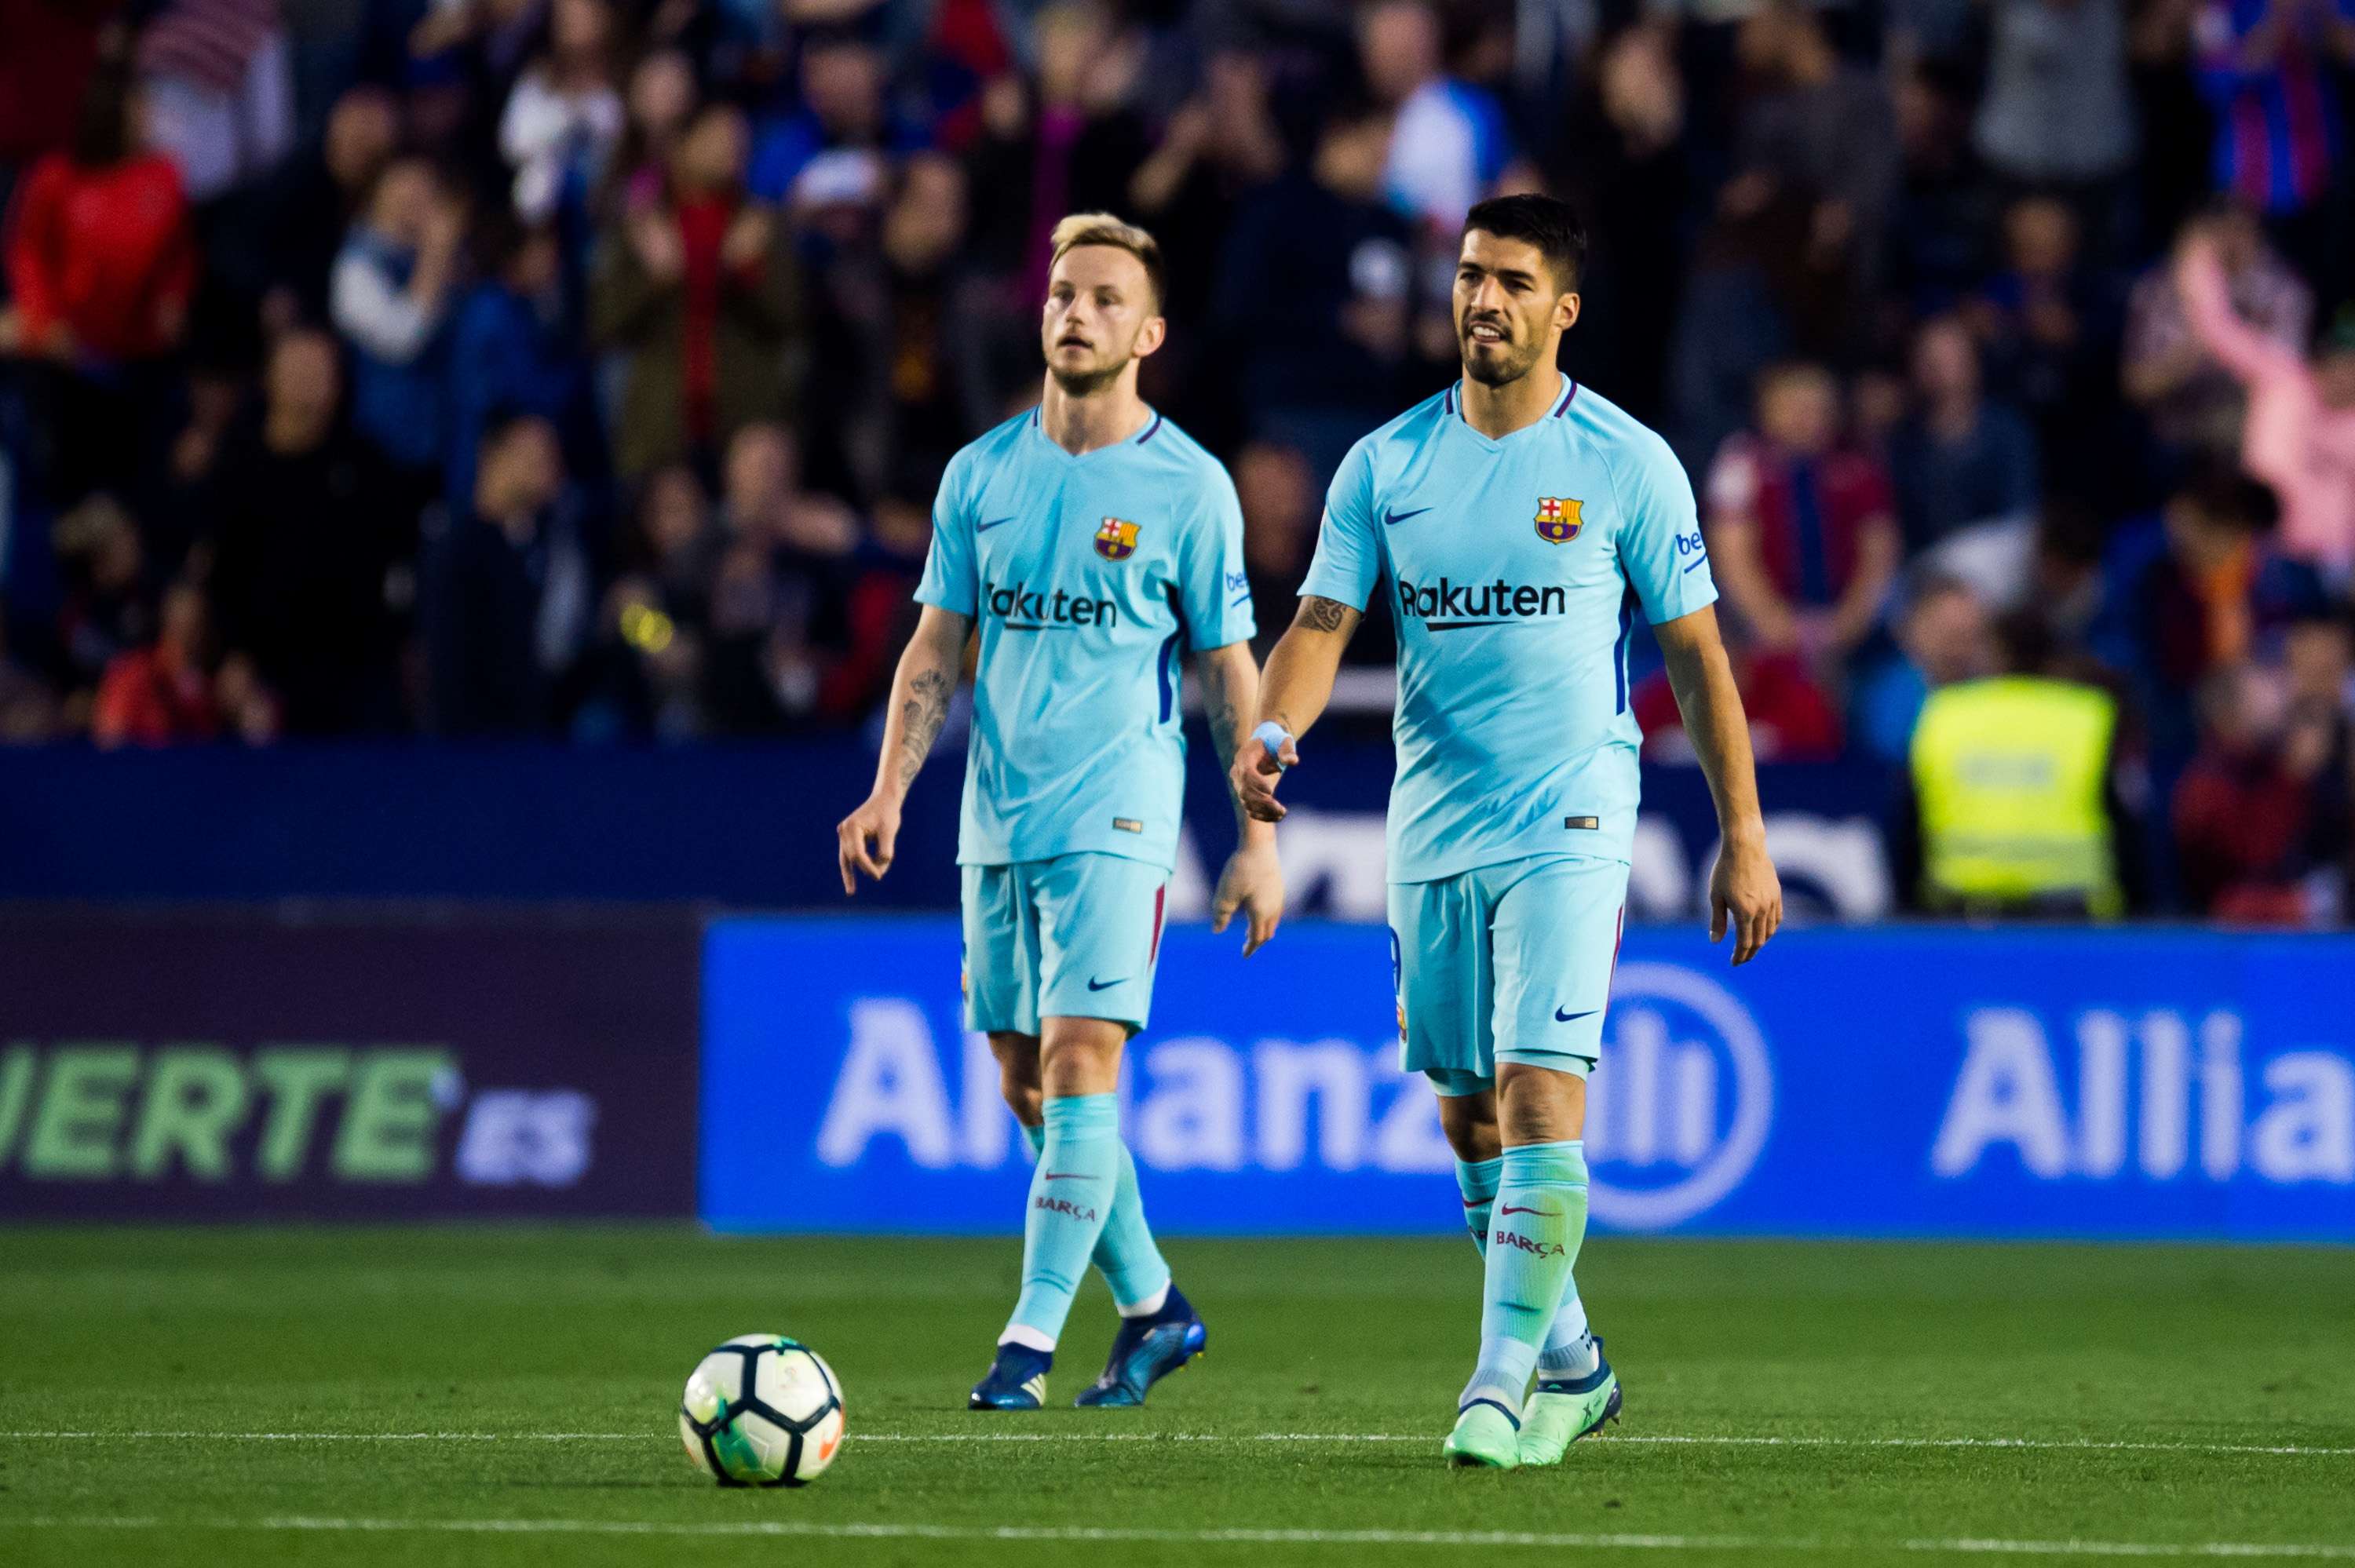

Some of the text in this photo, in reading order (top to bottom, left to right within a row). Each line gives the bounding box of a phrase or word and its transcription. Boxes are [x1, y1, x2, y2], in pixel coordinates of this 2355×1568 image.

[1399, 578, 1565, 617] Rakuten
[1931, 1008, 2355, 1181] Allia
[1496, 1231, 1565, 1259] BARÇA
